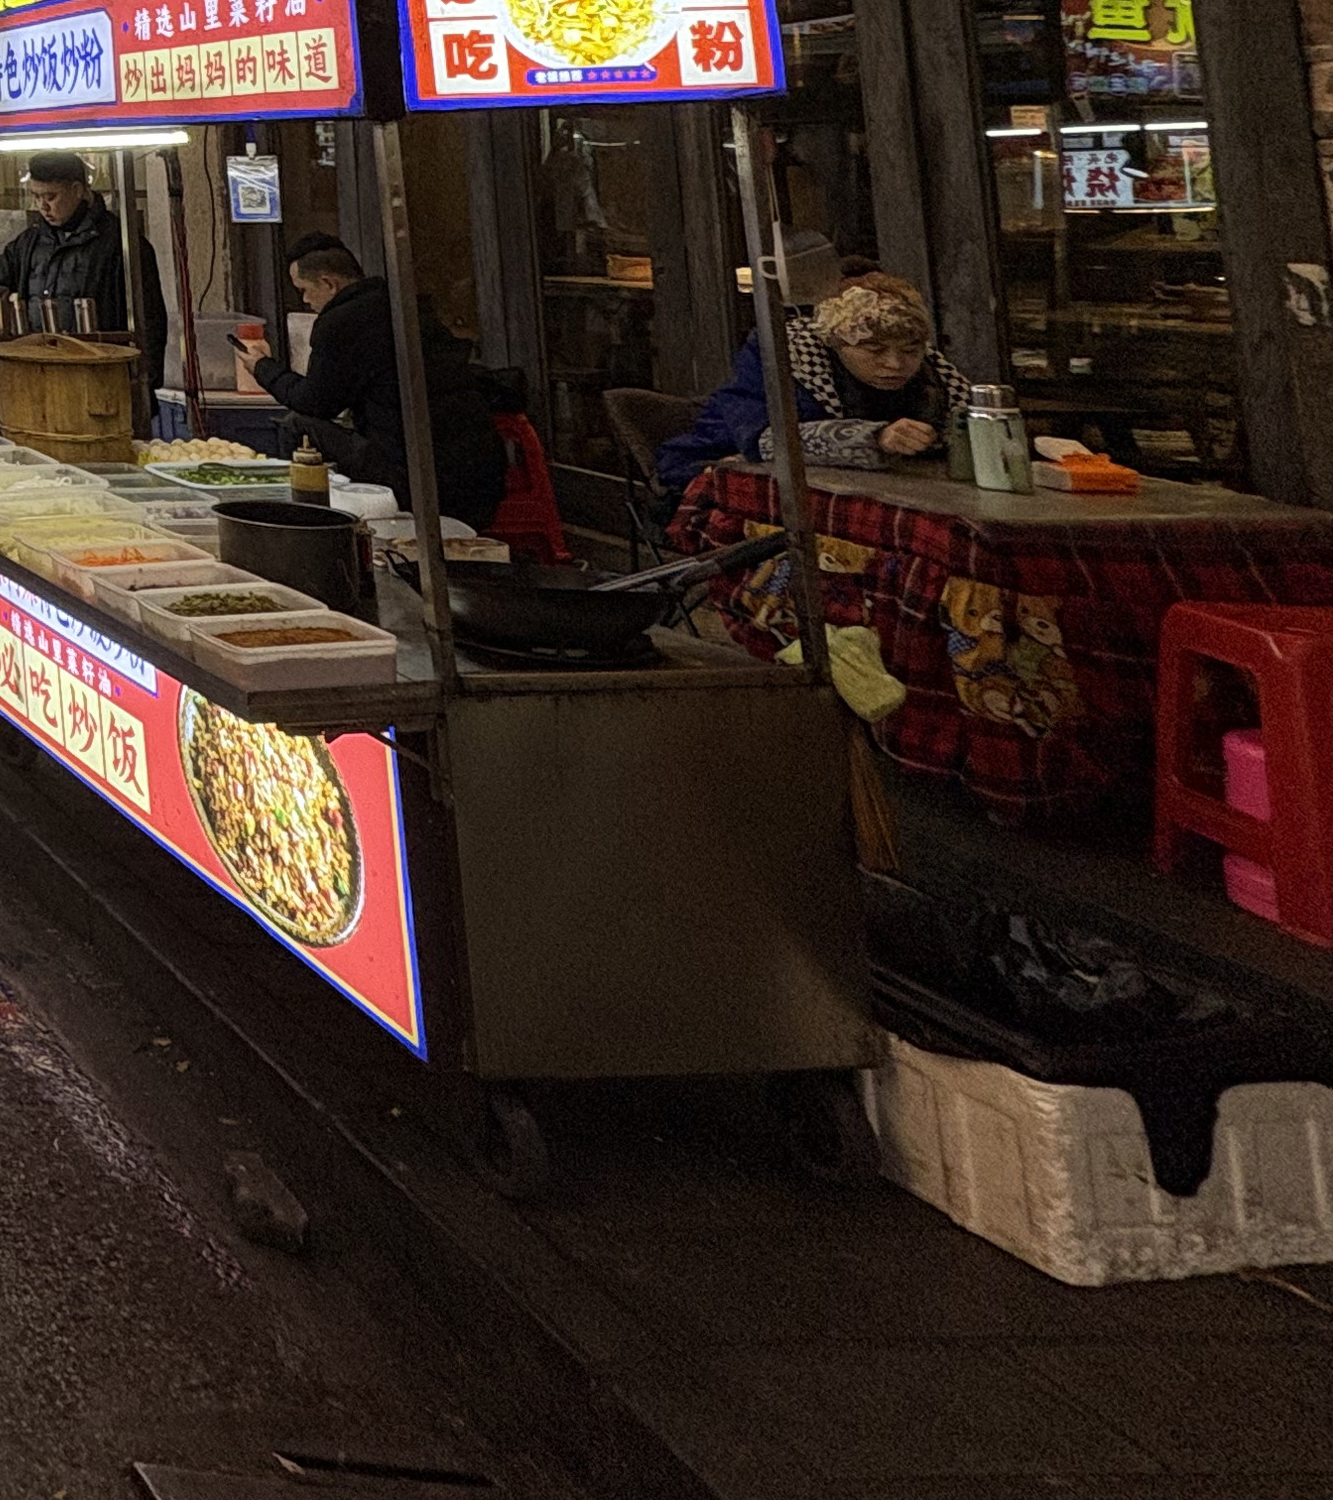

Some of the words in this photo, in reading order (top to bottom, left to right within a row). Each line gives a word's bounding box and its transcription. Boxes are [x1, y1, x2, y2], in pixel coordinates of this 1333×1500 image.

[124, 34, 333, 99] 炒出妈妈的味道
[10, 609, 113, 698] 精选山里菜籽油
